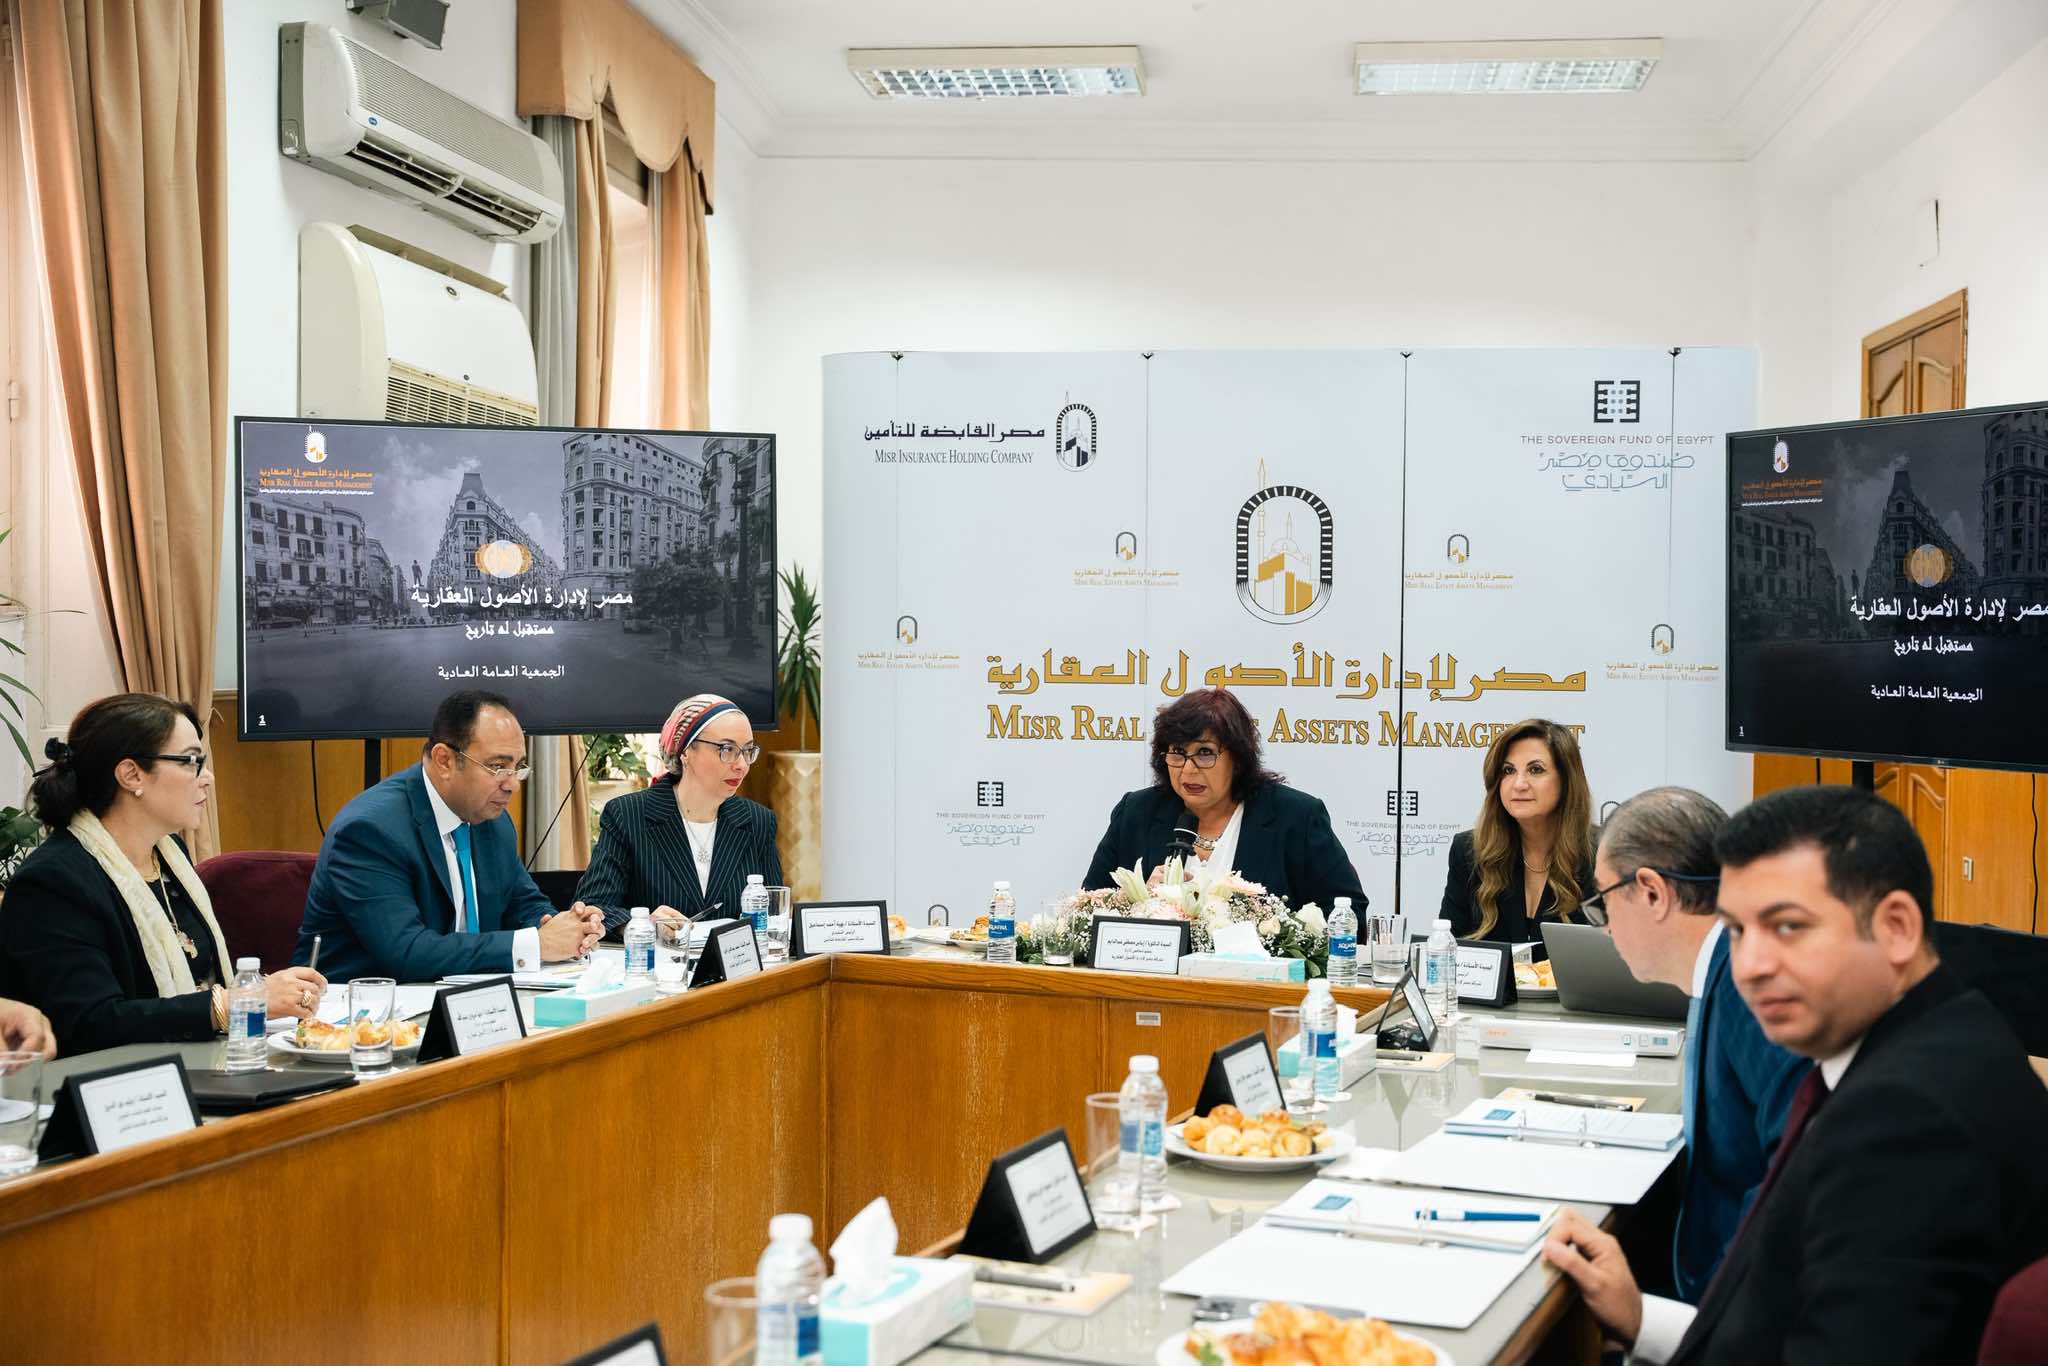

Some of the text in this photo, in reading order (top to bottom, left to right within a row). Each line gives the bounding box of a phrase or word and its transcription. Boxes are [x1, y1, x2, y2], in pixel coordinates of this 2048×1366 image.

[864, 420, 1046, 443] مصر القابضة للتأمين
[1520, 435, 1715, 445] THE SOVEREIGN FUND OF EGYPT
[874, 449, 1034, 464] MISR INSURANCE HOLDING COMPANY
[410, 583, 633, 610] مصر لإدارة الأصول العقارية
[1850, 595, 1902, 621] العقارية
[1906, 594, 1958, 621] الأصول
[1965, 597, 2007, 622] لإدارة
[464, 620, 555, 640] مستقبل له تاريخ
[1893, 636, 1974, 656] مستقبل له تاريخ
[438, 664, 565, 680] الجمعية العامة العادية
[986, 641, 1586, 701] مصر لإدارة الأصول العقارية
[1871, 684, 1983, 703] الجمعية العامة العادية
[258, 714, 267, 726] 1
[987, 704, 1063, 740] MISR
[1071, 705, 1145, 741] REAL
[1267, 708, 1370, 745] ASSETS
[1738, 726, 1744, 737] 1
